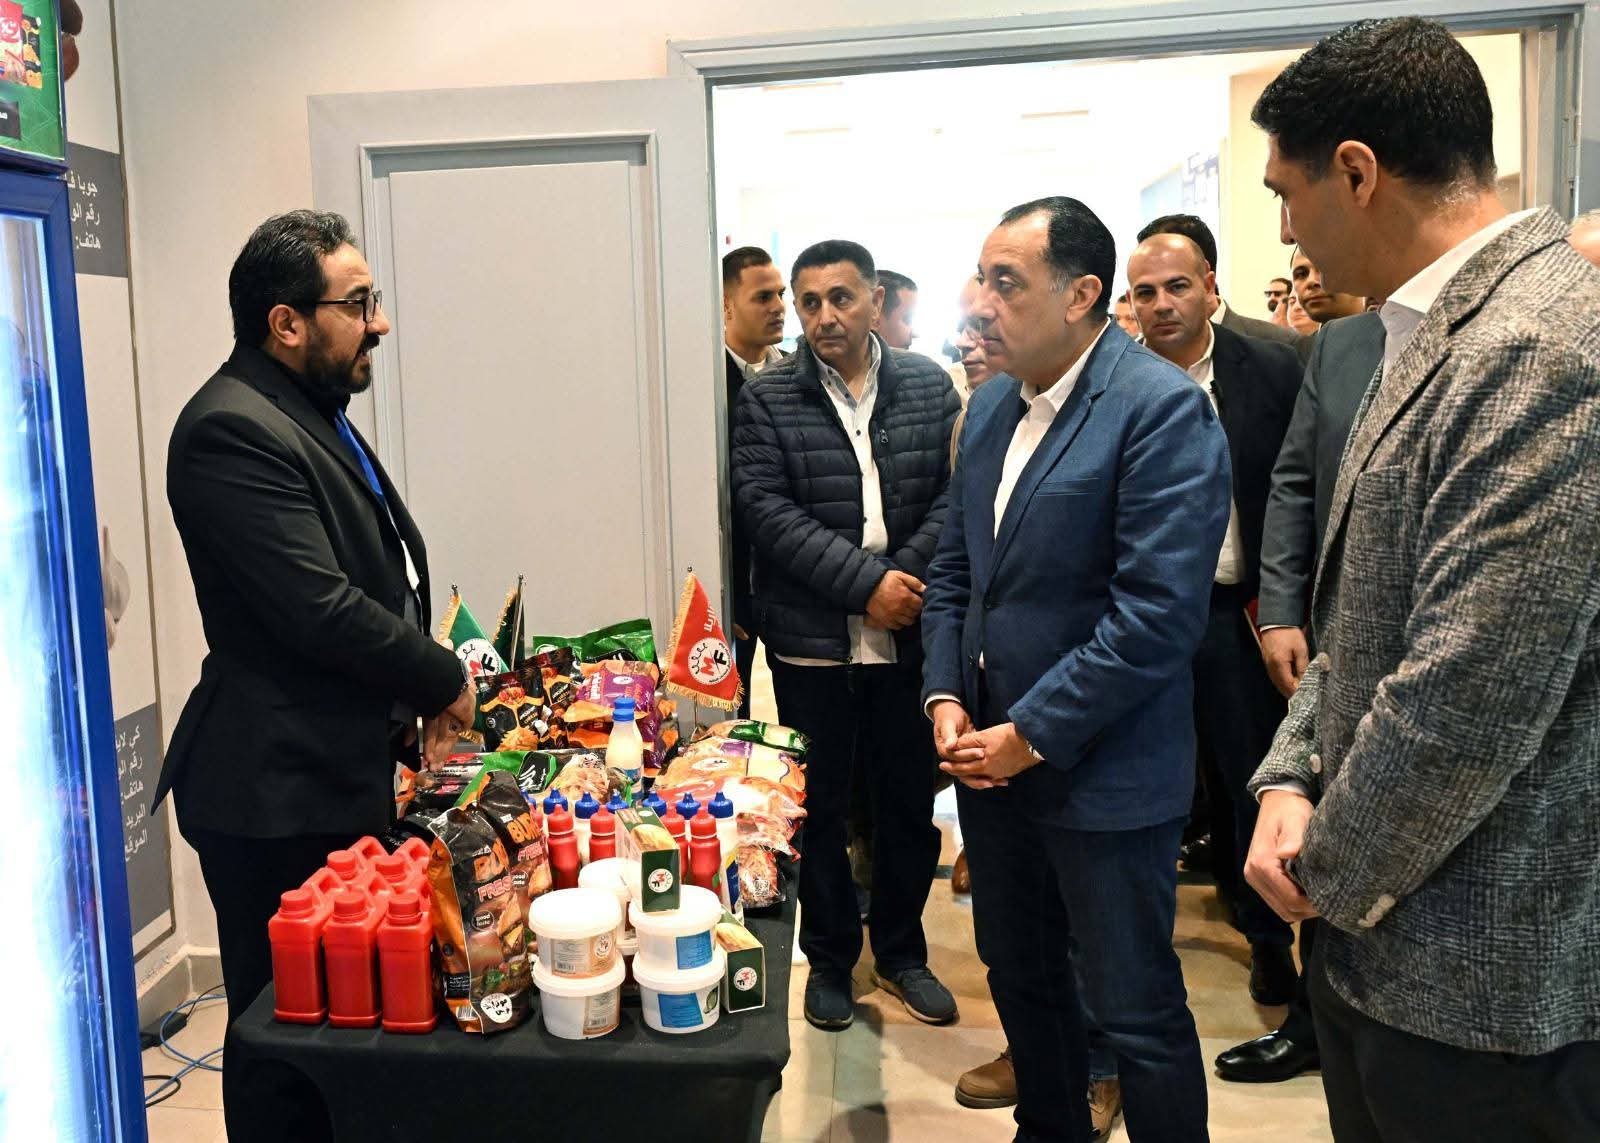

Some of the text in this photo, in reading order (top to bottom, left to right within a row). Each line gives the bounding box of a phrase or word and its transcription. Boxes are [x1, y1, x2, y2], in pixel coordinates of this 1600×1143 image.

[78, 174, 98, 197] جوبا
[70, 202, 101, 227] رقم الو
[118, 751, 143, 781] رقم الو
[125, 803, 147, 830] البريد
[506, 812, 542, 844] BUR
[124, 828, 149, 863] الموقع
[477, 875, 512, 902] FRES
